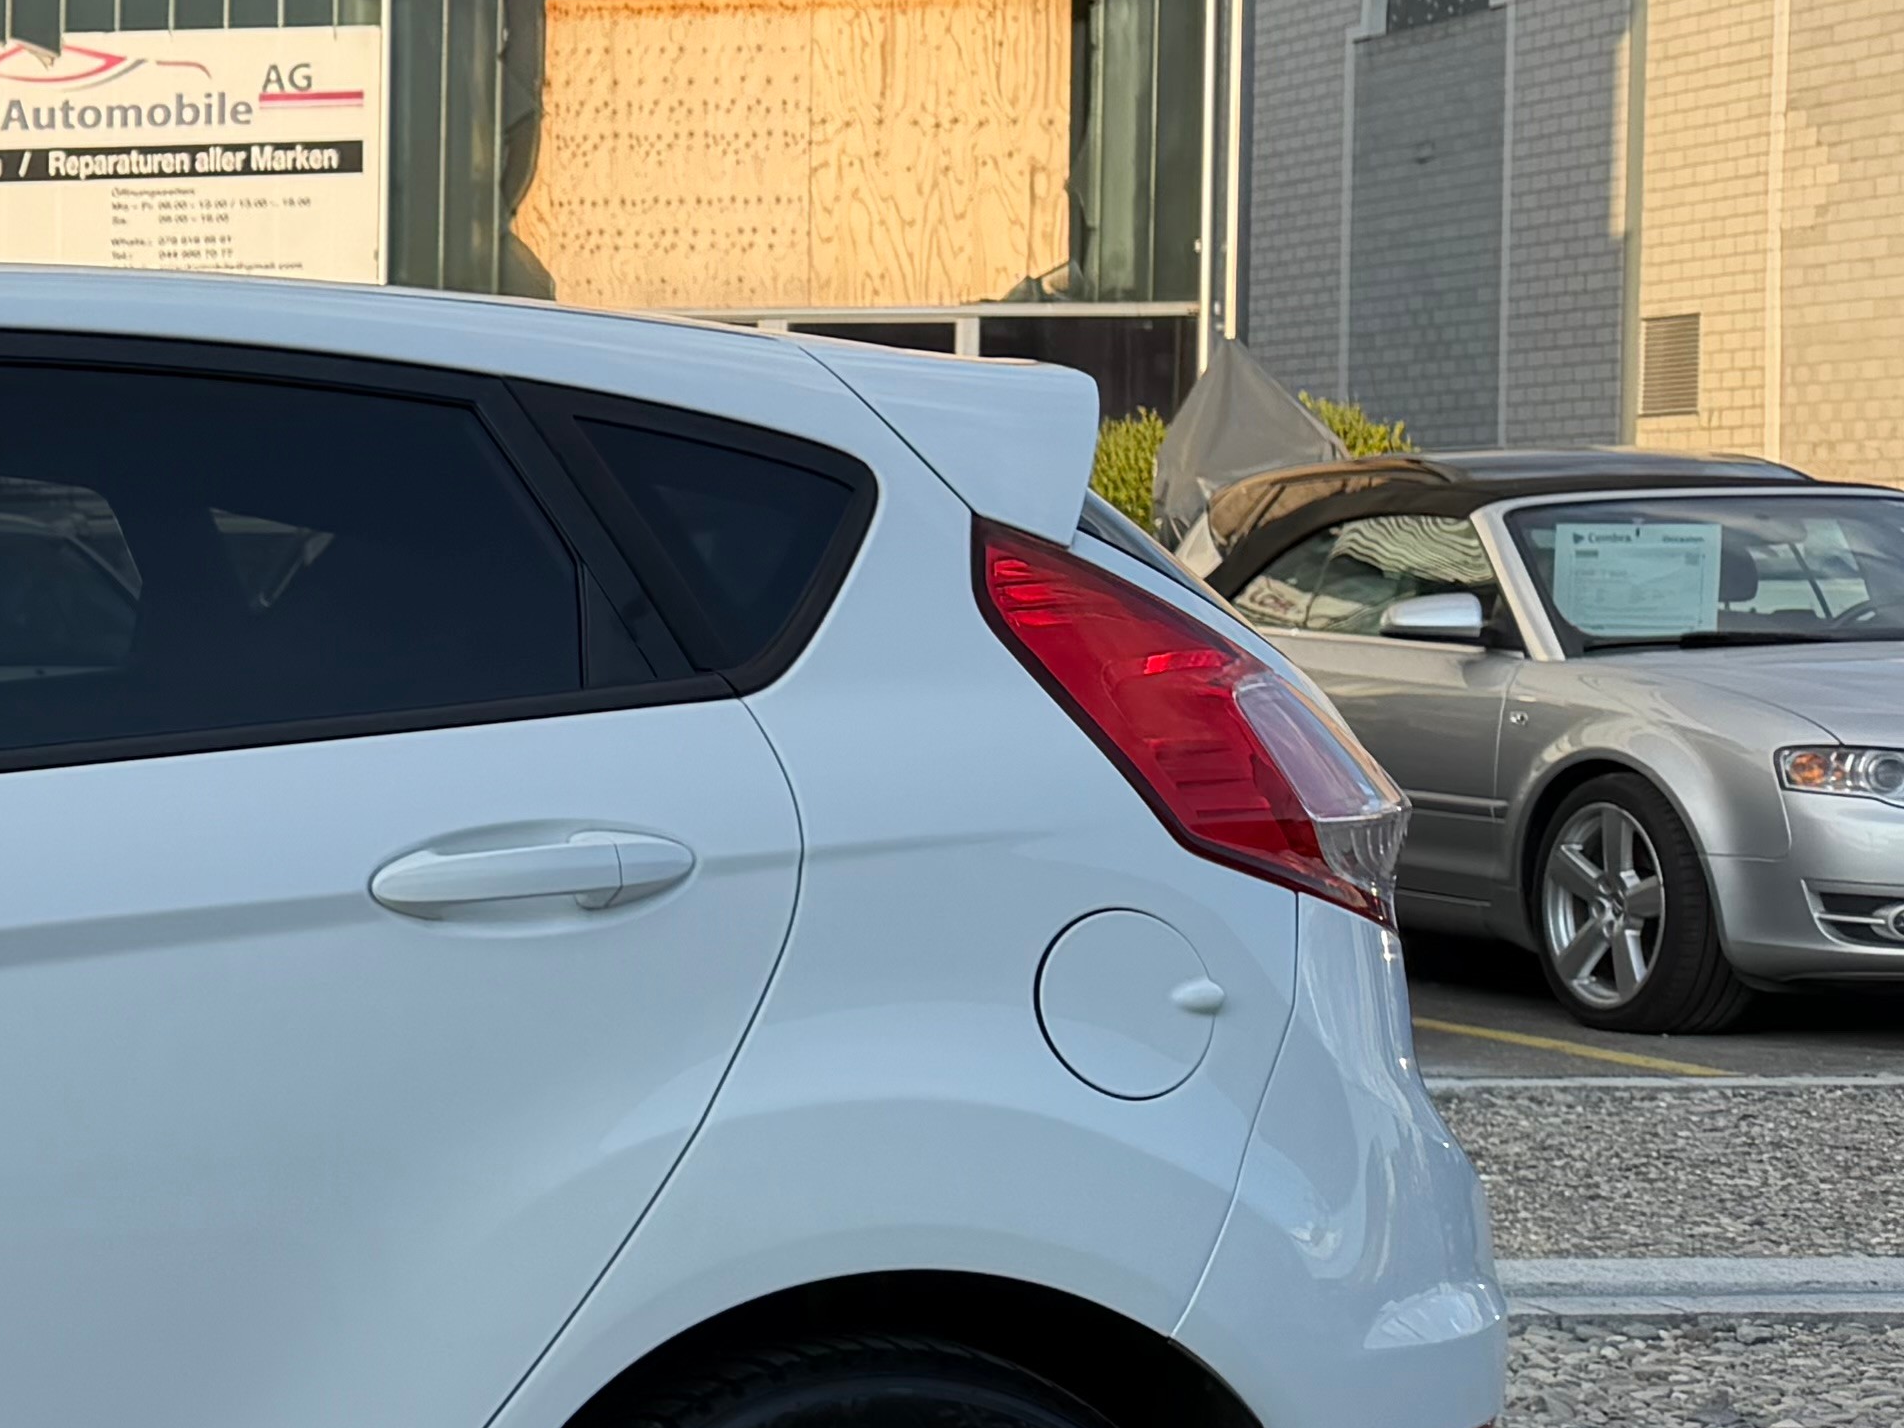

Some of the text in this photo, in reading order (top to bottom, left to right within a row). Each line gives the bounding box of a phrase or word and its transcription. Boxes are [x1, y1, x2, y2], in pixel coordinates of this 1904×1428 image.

[1, 92, 253, 132] Automobile
[262, 64, 313, 93] AG
[48, 149, 191, 180] Reparaturen
[195, 146, 246, 174] aller
[250, 144, 339, 171] Marken
